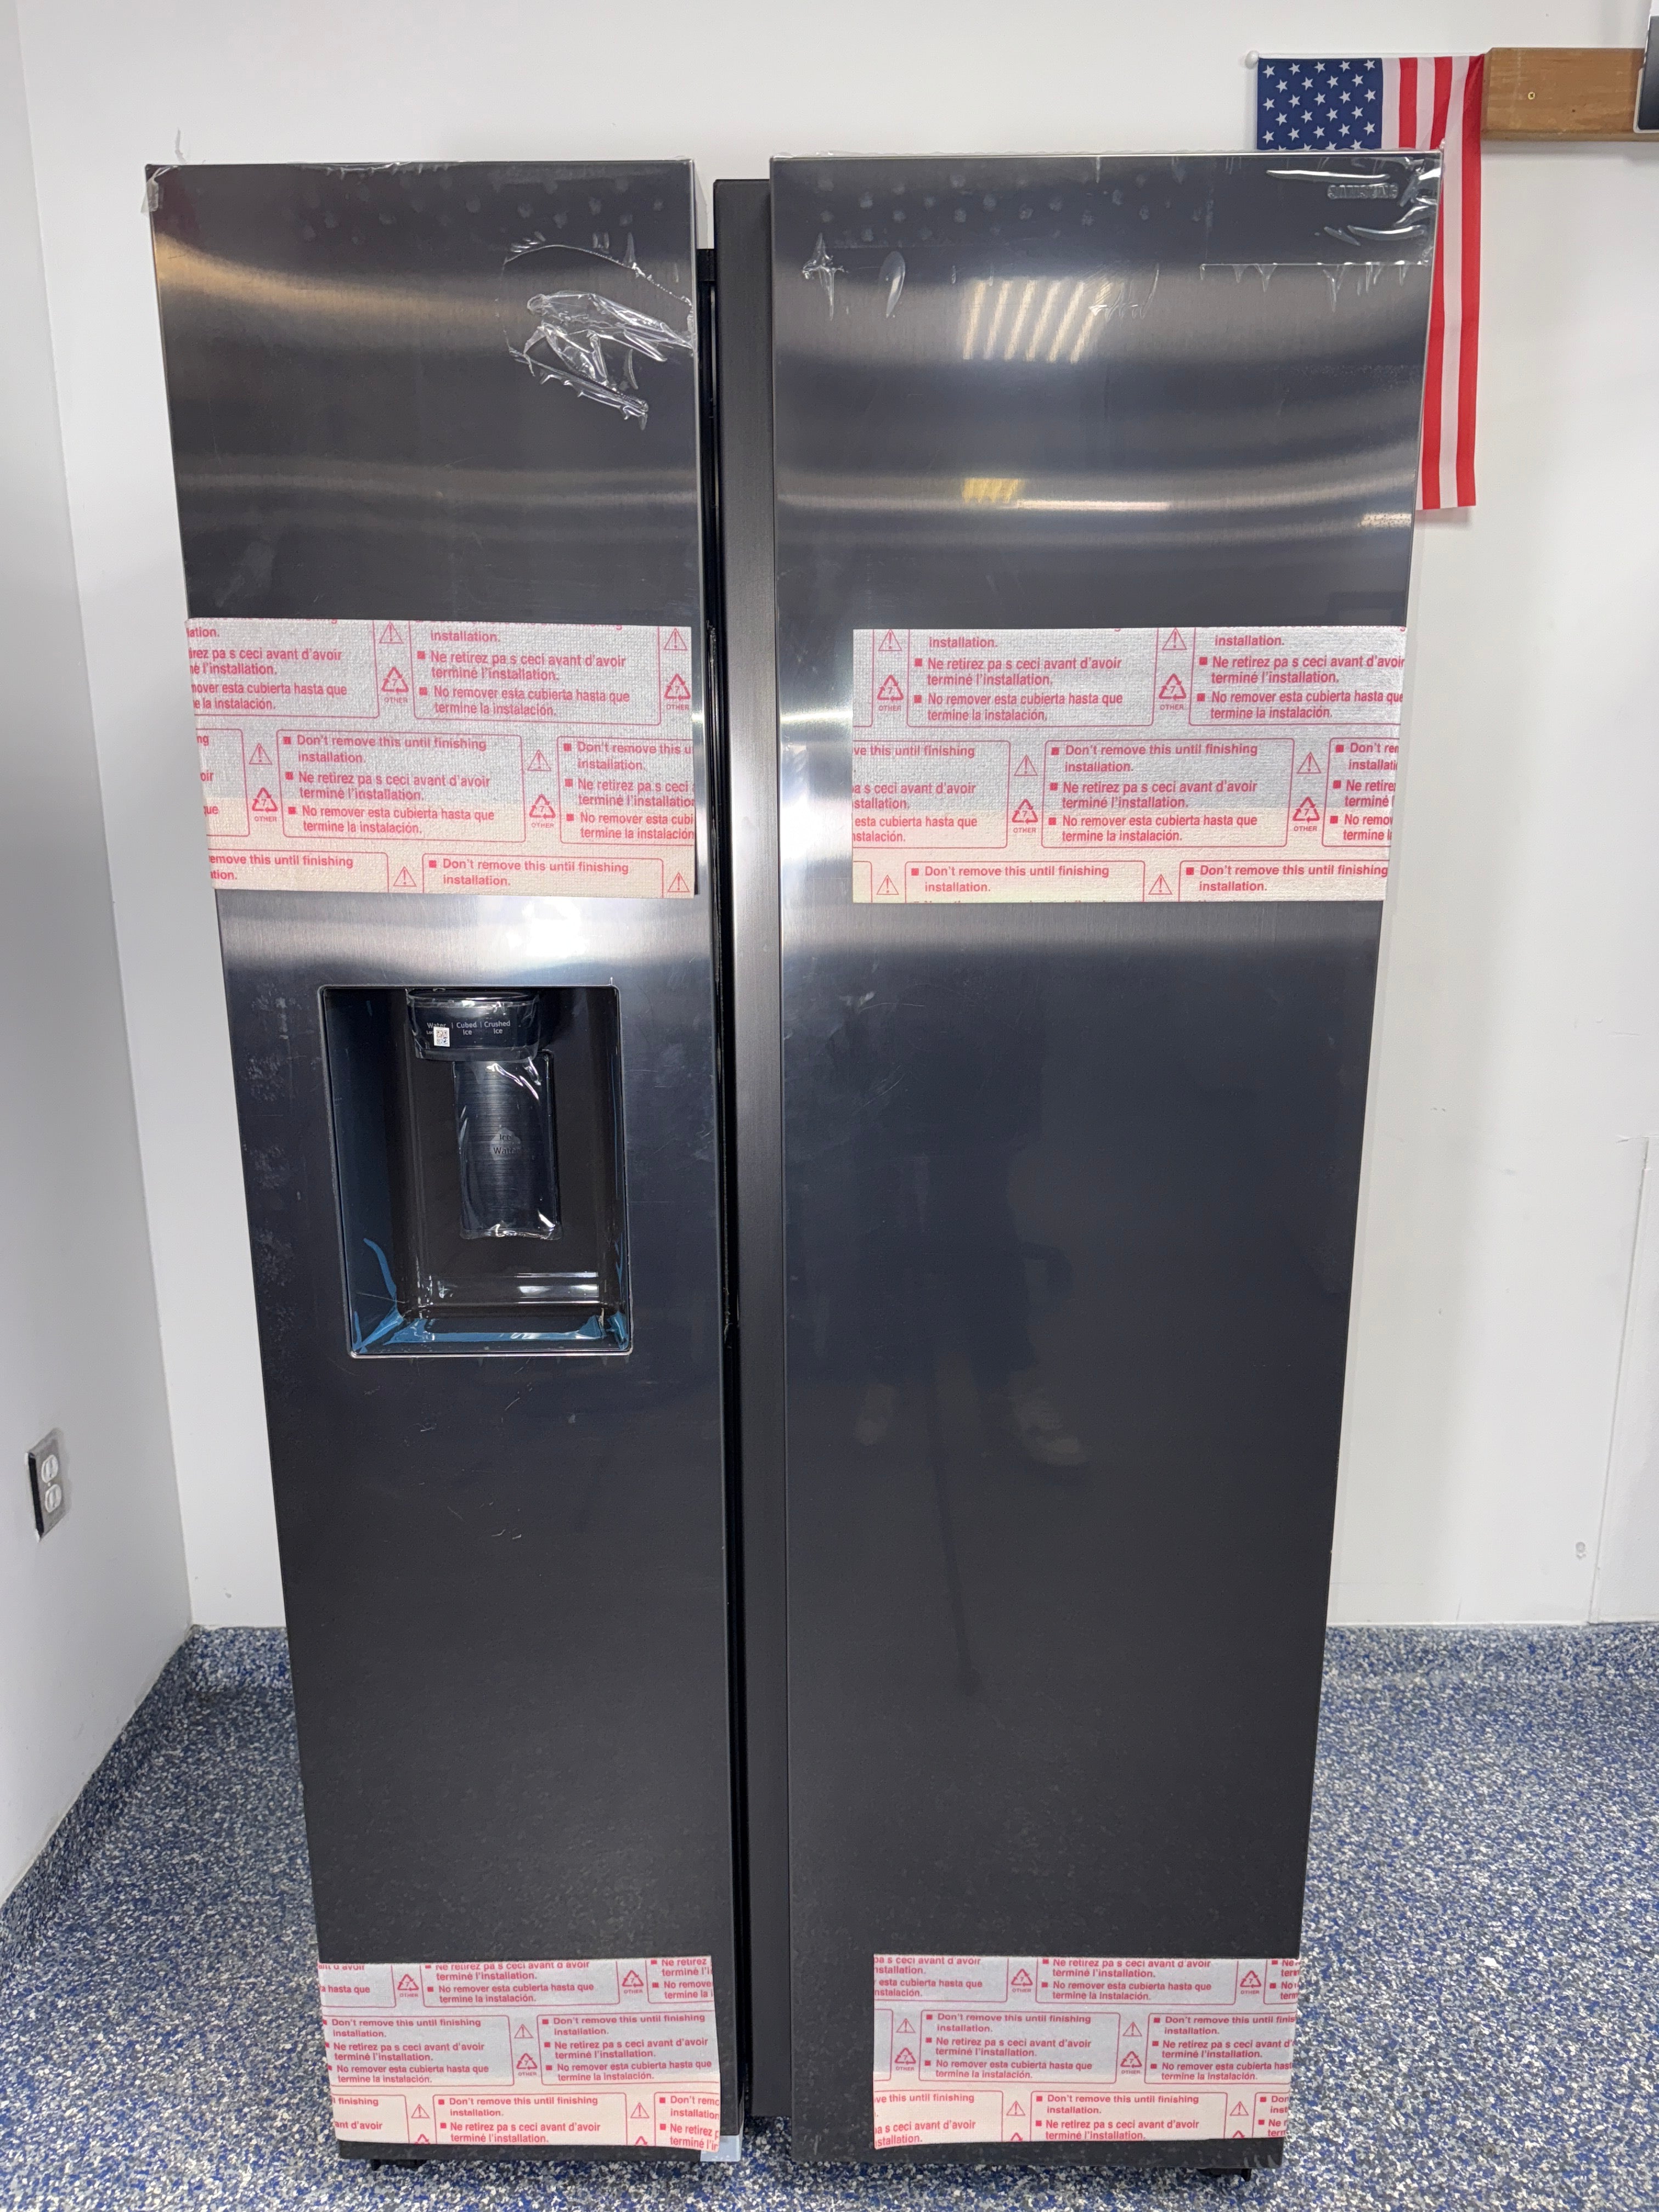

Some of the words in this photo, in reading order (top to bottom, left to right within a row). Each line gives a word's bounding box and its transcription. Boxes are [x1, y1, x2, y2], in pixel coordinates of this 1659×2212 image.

[430, 631, 501, 643] installation.
[929, 636, 997, 648] installation.
[430, 652, 447, 663] Ne
[450, 652, 488, 664] retirez
[492, 656, 506, 667] pa
[510, 656, 517, 664] s
[520, 654, 545, 665] ceci
[548, 654, 582, 666] avant
[584, 655, 625, 667] d'avoir
[928, 658, 944, 669] Ne
[947, 658, 984, 669] retirez
[987, 660, 1002, 672] pa
[1006, 660, 1013, 669] s
[1015, 658, 1040, 669] ceci
[1043, 658, 1077, 669] avant
[1080, 657, 1121, 669] d'avoir
[481, 669, 560, 681] l'installation.
[976, 674, 1052, 685] l'installation.
[434, 686, 450, 697] No
[453, 689, 498, 698] remover
[501, 688, 525, 699] esta
[527, 689, 573, 701] cubierta
[575, 690, 606, 702] hasta
[609, 693, 630, 705] que
[928, 693, 943, 704] No
[946, 696, 991, 704] remover
[994, 693, 1017, 704] esta
[1020, 693, 1065, 704] cubierta
[1068, 693, 1099, 704] hasta
[1102, 695, 1123, 707] que
[434, 702, 477, 714] termine
[480, 703, 490, 714] la
[493, 704, 557, 716] instalación.
[927, 709, 969, 720] termine
[972, 709, 981, 720] la
[984, 709, 1047, 721] instalación.
[297, 736, 329, 747] Don't
[331, 738, 376, 747] remove
[378, 737, 400, 748] this
[404, 737, 431, 748] until
[434, 738, 487, 752] finishing
[1065, 744, 1097, 755] Don't
[1101, 746, 1146, 755] remove
[1149, 744, 1171, 755] this
[1175, 744, 1201, 755] until
[1205, 744, 1257, 758] finishing
[298, 752, 366, 763] installation.
[1065, 760, 1133, 772] installation.
[298, 772, 314, 783] Ne
[317, 773, 354, 784] retirez
[357, 776, 372, 787] pa
[375, 776, 382, 785] s
[386, 774, 409, 785] ceci
[414, 775, 445, 786] avant
[449, 775, 489, 787] d'avoir
[1063, 782, 1079, 793] Ne
[1082, 782, 1119, 793] retirez
[1122, 784, 1138, 795] pa
[1141, 784, 1148, 793] s
[1152, 781, 1176, 793] ceci
[1179, 781, 1212, 793] avant
[1216, 781, 1257, 792] d'avoir
[348, 789, 424, 800] l'installation.
[1111, 797, 1189, 808] l'installation.
[302, 806, 318, 817] No
[320, 809, 364, 817] remover
[367, 807, 391, 818] esta
[393, 808, 438, 819] cubierta
[441, 809, 471, 820] hasta
[474, 811, 494, 822] que
[303, 821, 345, 832] termine
[347, 822, 357, 832] la
[359, 822, 422, 834] instalación.
[1063, 815, 1077, 826] No
[1081, 817, 1126, 826] remover
[1128, 815, 1152, 826] esta
[1155, 815, 1200, 826] cubierta
[1203, 815, 1233, 826] hasta
[1236, 817, 1257, 828] que
[1062, 830, 1103, 841] termine
[1107, 830, 1116, 841] la
[1119, 830, 1183, 841] instalación.
[925, 865, 955, 876] Don't
[958, 867, 1002, 876] remove
[1005, 865, 1026, 876] this
[1030, 865, 1055, 876] until
[1058, 865, 1109, 879] finishing
[925, 881, 991, 893] installation.
[439, 2020, 481, 2029] finishing
[938, 2013, 963, 2021] Don't
[1005, 2014, 1023, 2022] this
[1025, 2014, 1047, 2022] until
[1049, 2015, 1091, 2025] finishing
[937, 2024, 994, 2033] installation.
[452, 2043, 484, 2051] d'avoir
[951, 2038, 981, 2046] retirez
[984, 2040, 996, 2048] pa
[1029, 2039, 1056, 2047] avant
[1058, 2039, 1091, 2047] d'avoir
[975, 2049, 1037, 2057] l'installation.
[989, 2061, 1008, 2069] esta
[1011, 2061, 1047, 2069] cubierta
[1049, 2062, 1074, 2070] hasta
[1075, 2063, 1092, 2072] que
[935, 2070, 969, 2078] termine
[972, 2070, 979, 2078] la
[982, 2070, 1032, 2079] instalación.
